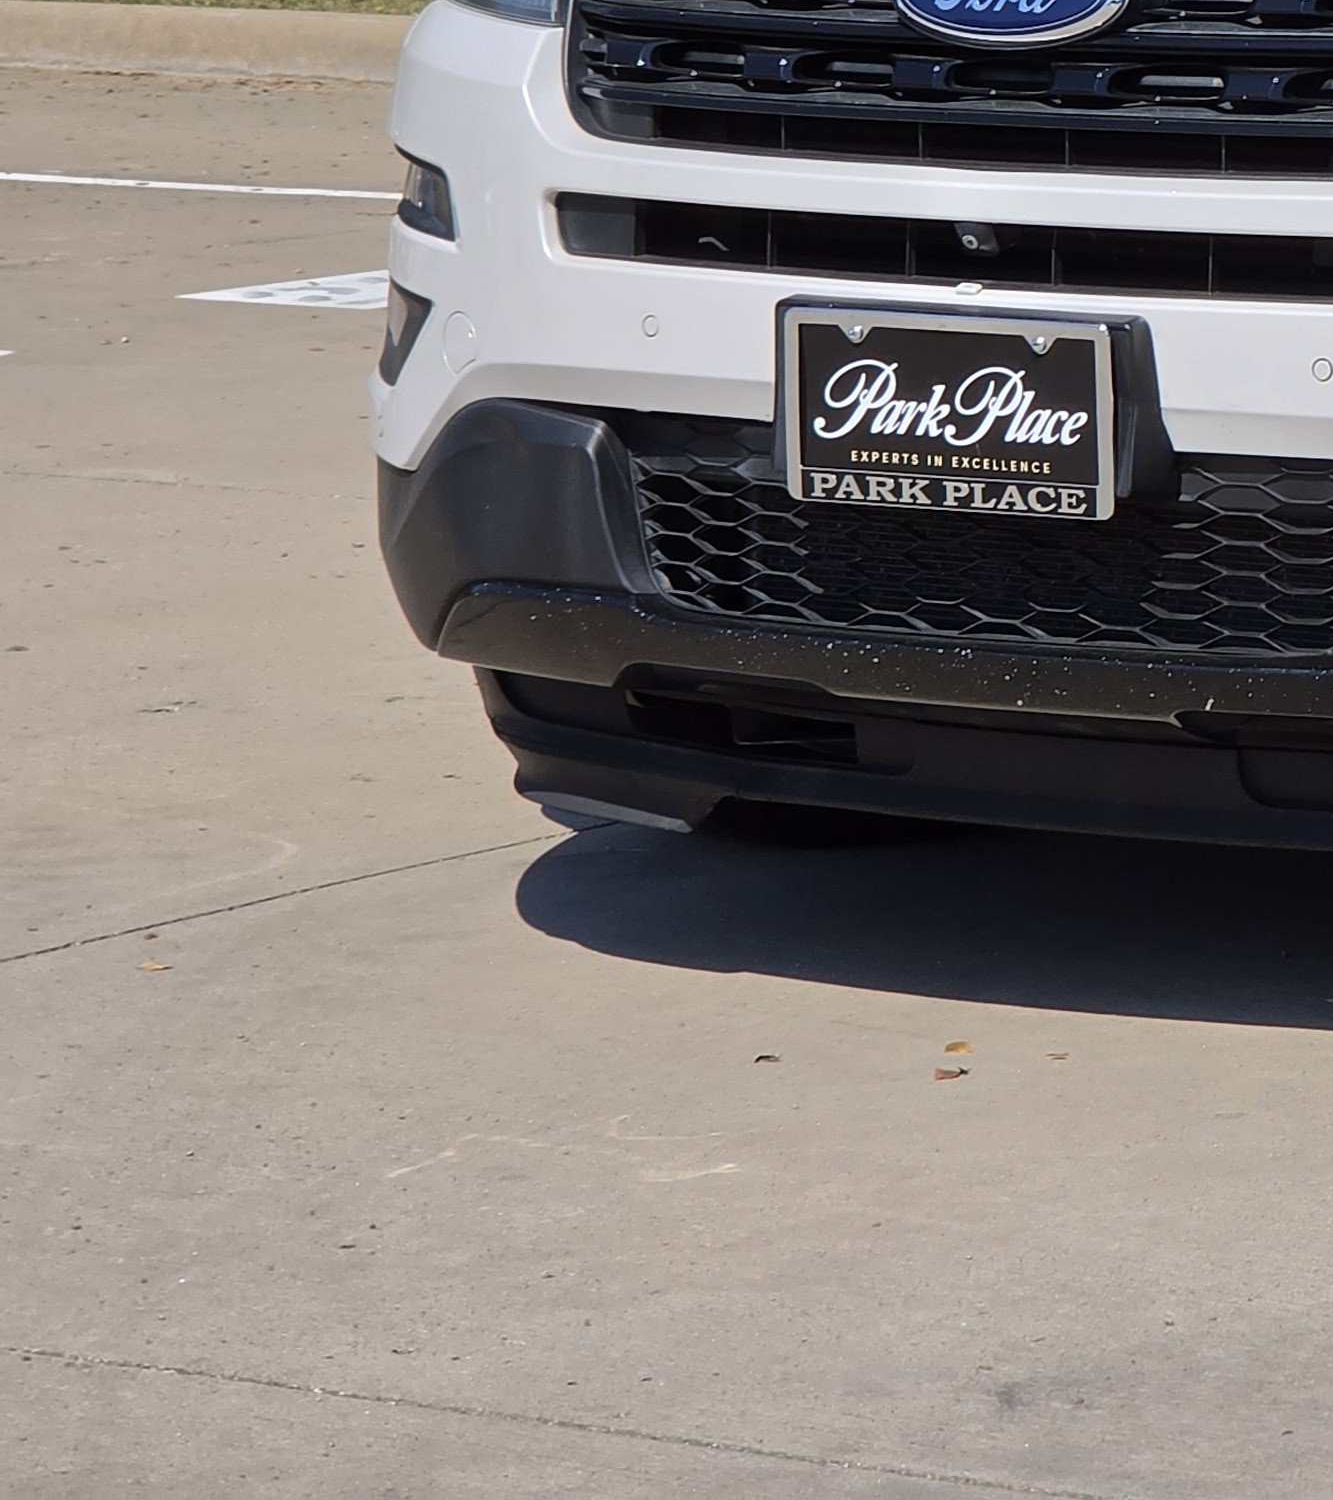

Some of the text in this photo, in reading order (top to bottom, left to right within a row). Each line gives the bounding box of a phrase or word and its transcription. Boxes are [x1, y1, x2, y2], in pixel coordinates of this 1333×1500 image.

[813, 359, 1088, 446] Park Place
[851, 450, 1051, 474] EXPERTS IN EXCELLENCE
[810, 472, 1088, 515] PARK PLACE
